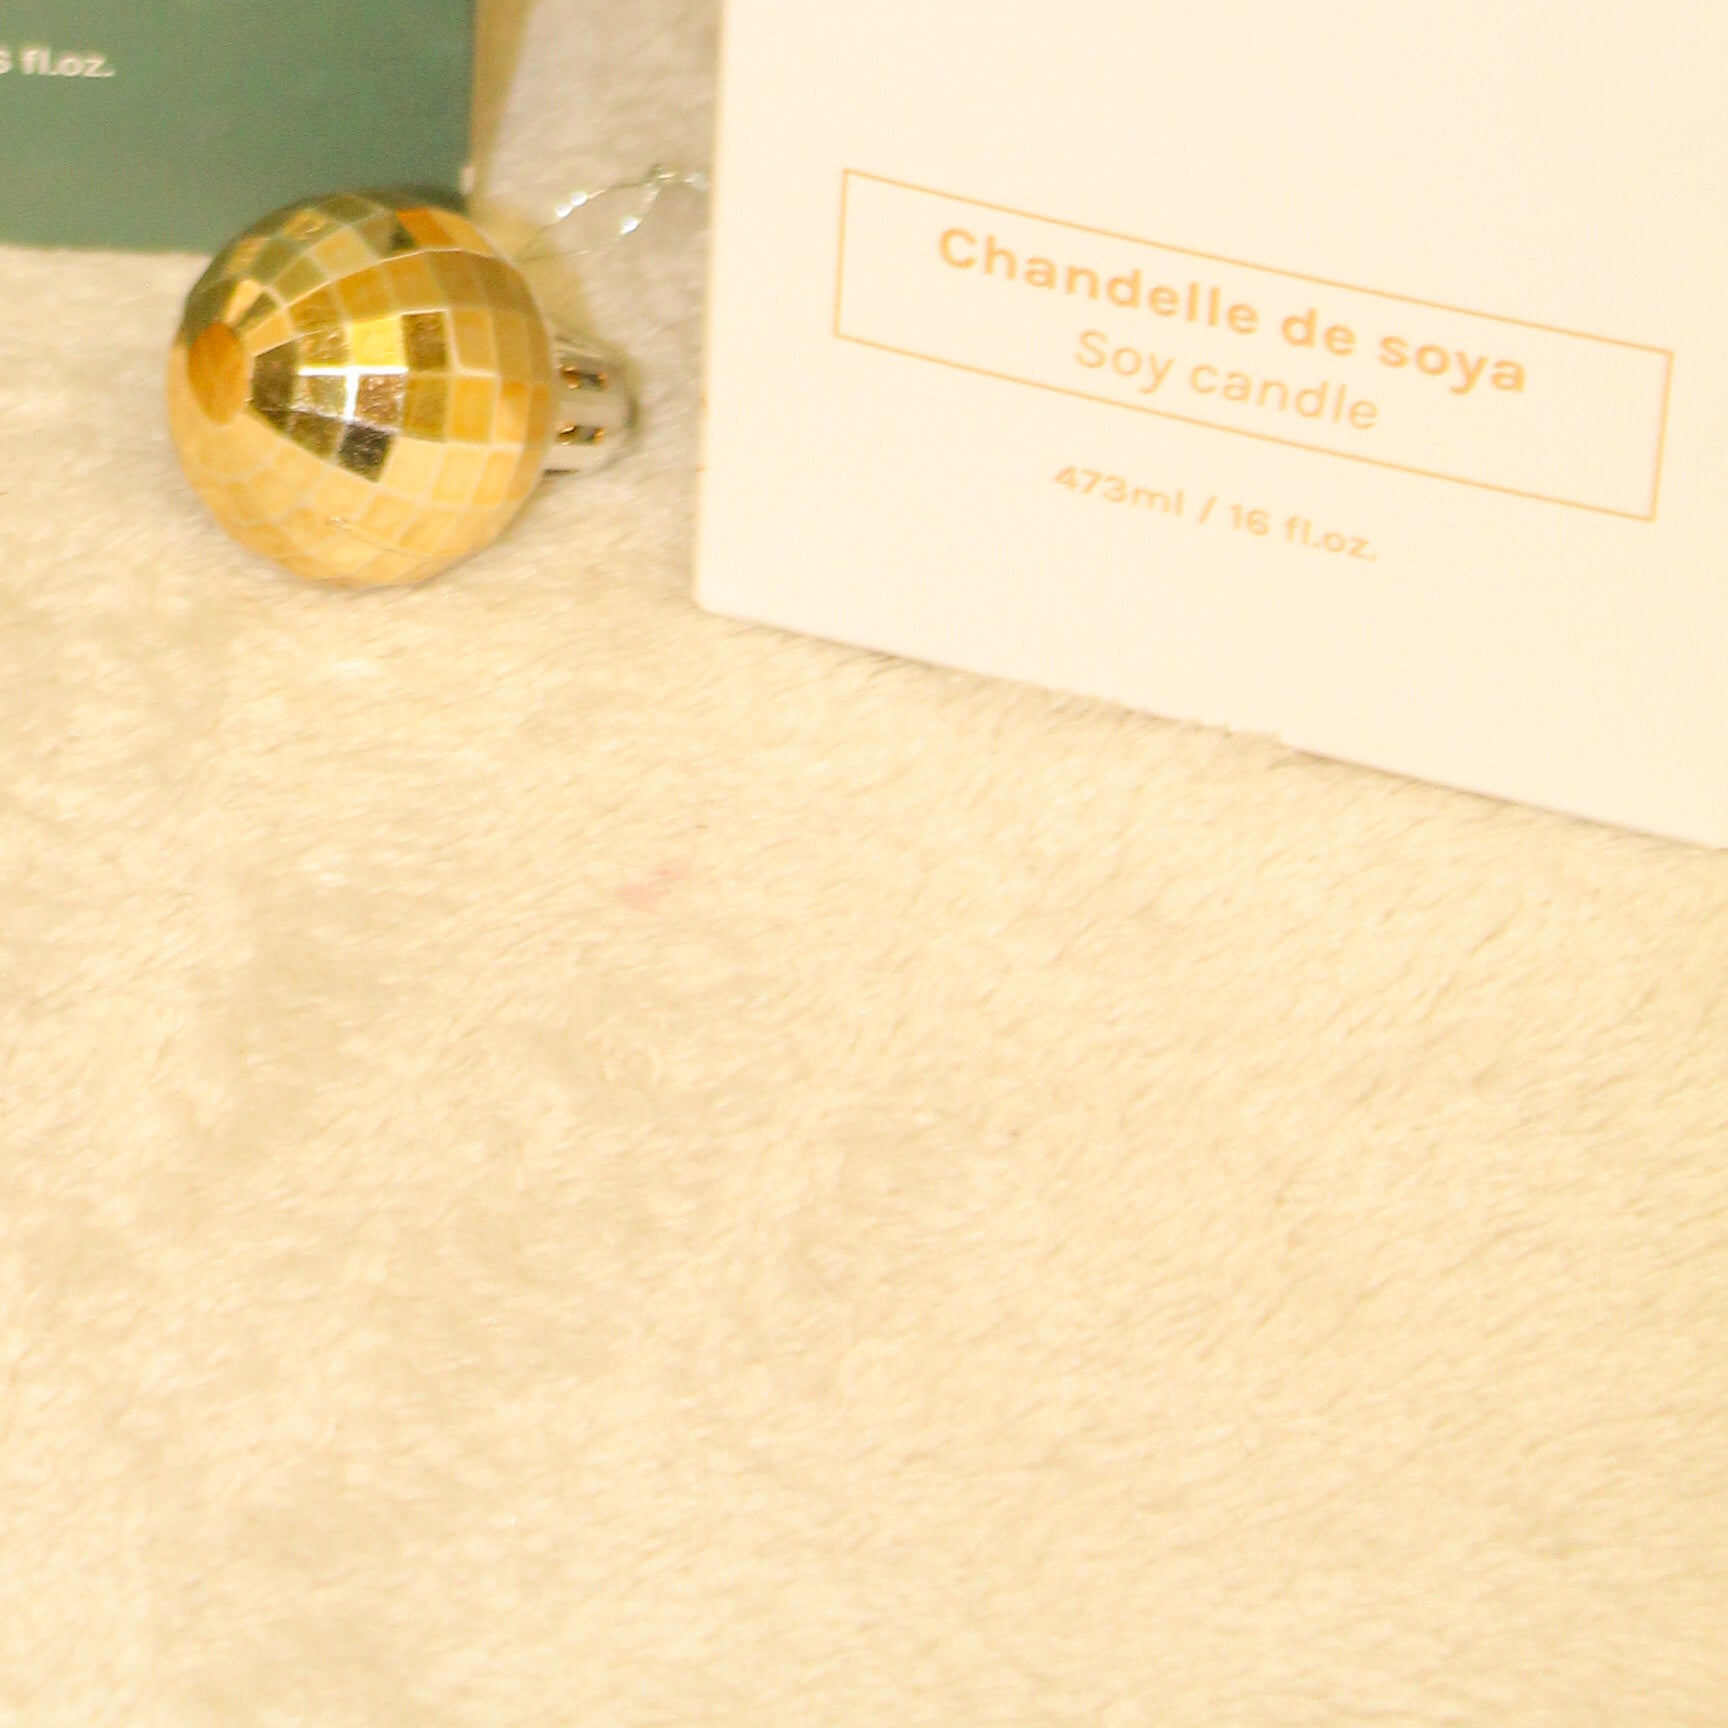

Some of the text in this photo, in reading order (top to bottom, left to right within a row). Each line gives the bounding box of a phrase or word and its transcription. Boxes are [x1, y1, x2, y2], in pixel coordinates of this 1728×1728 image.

[938, 226, 1526, 396] Chandelle de soya
[1076, 329, 1379, 430] Soy candle
[1053, 466, 1184, 517] 473ml
[1230, 503, 1271, 536] 16
